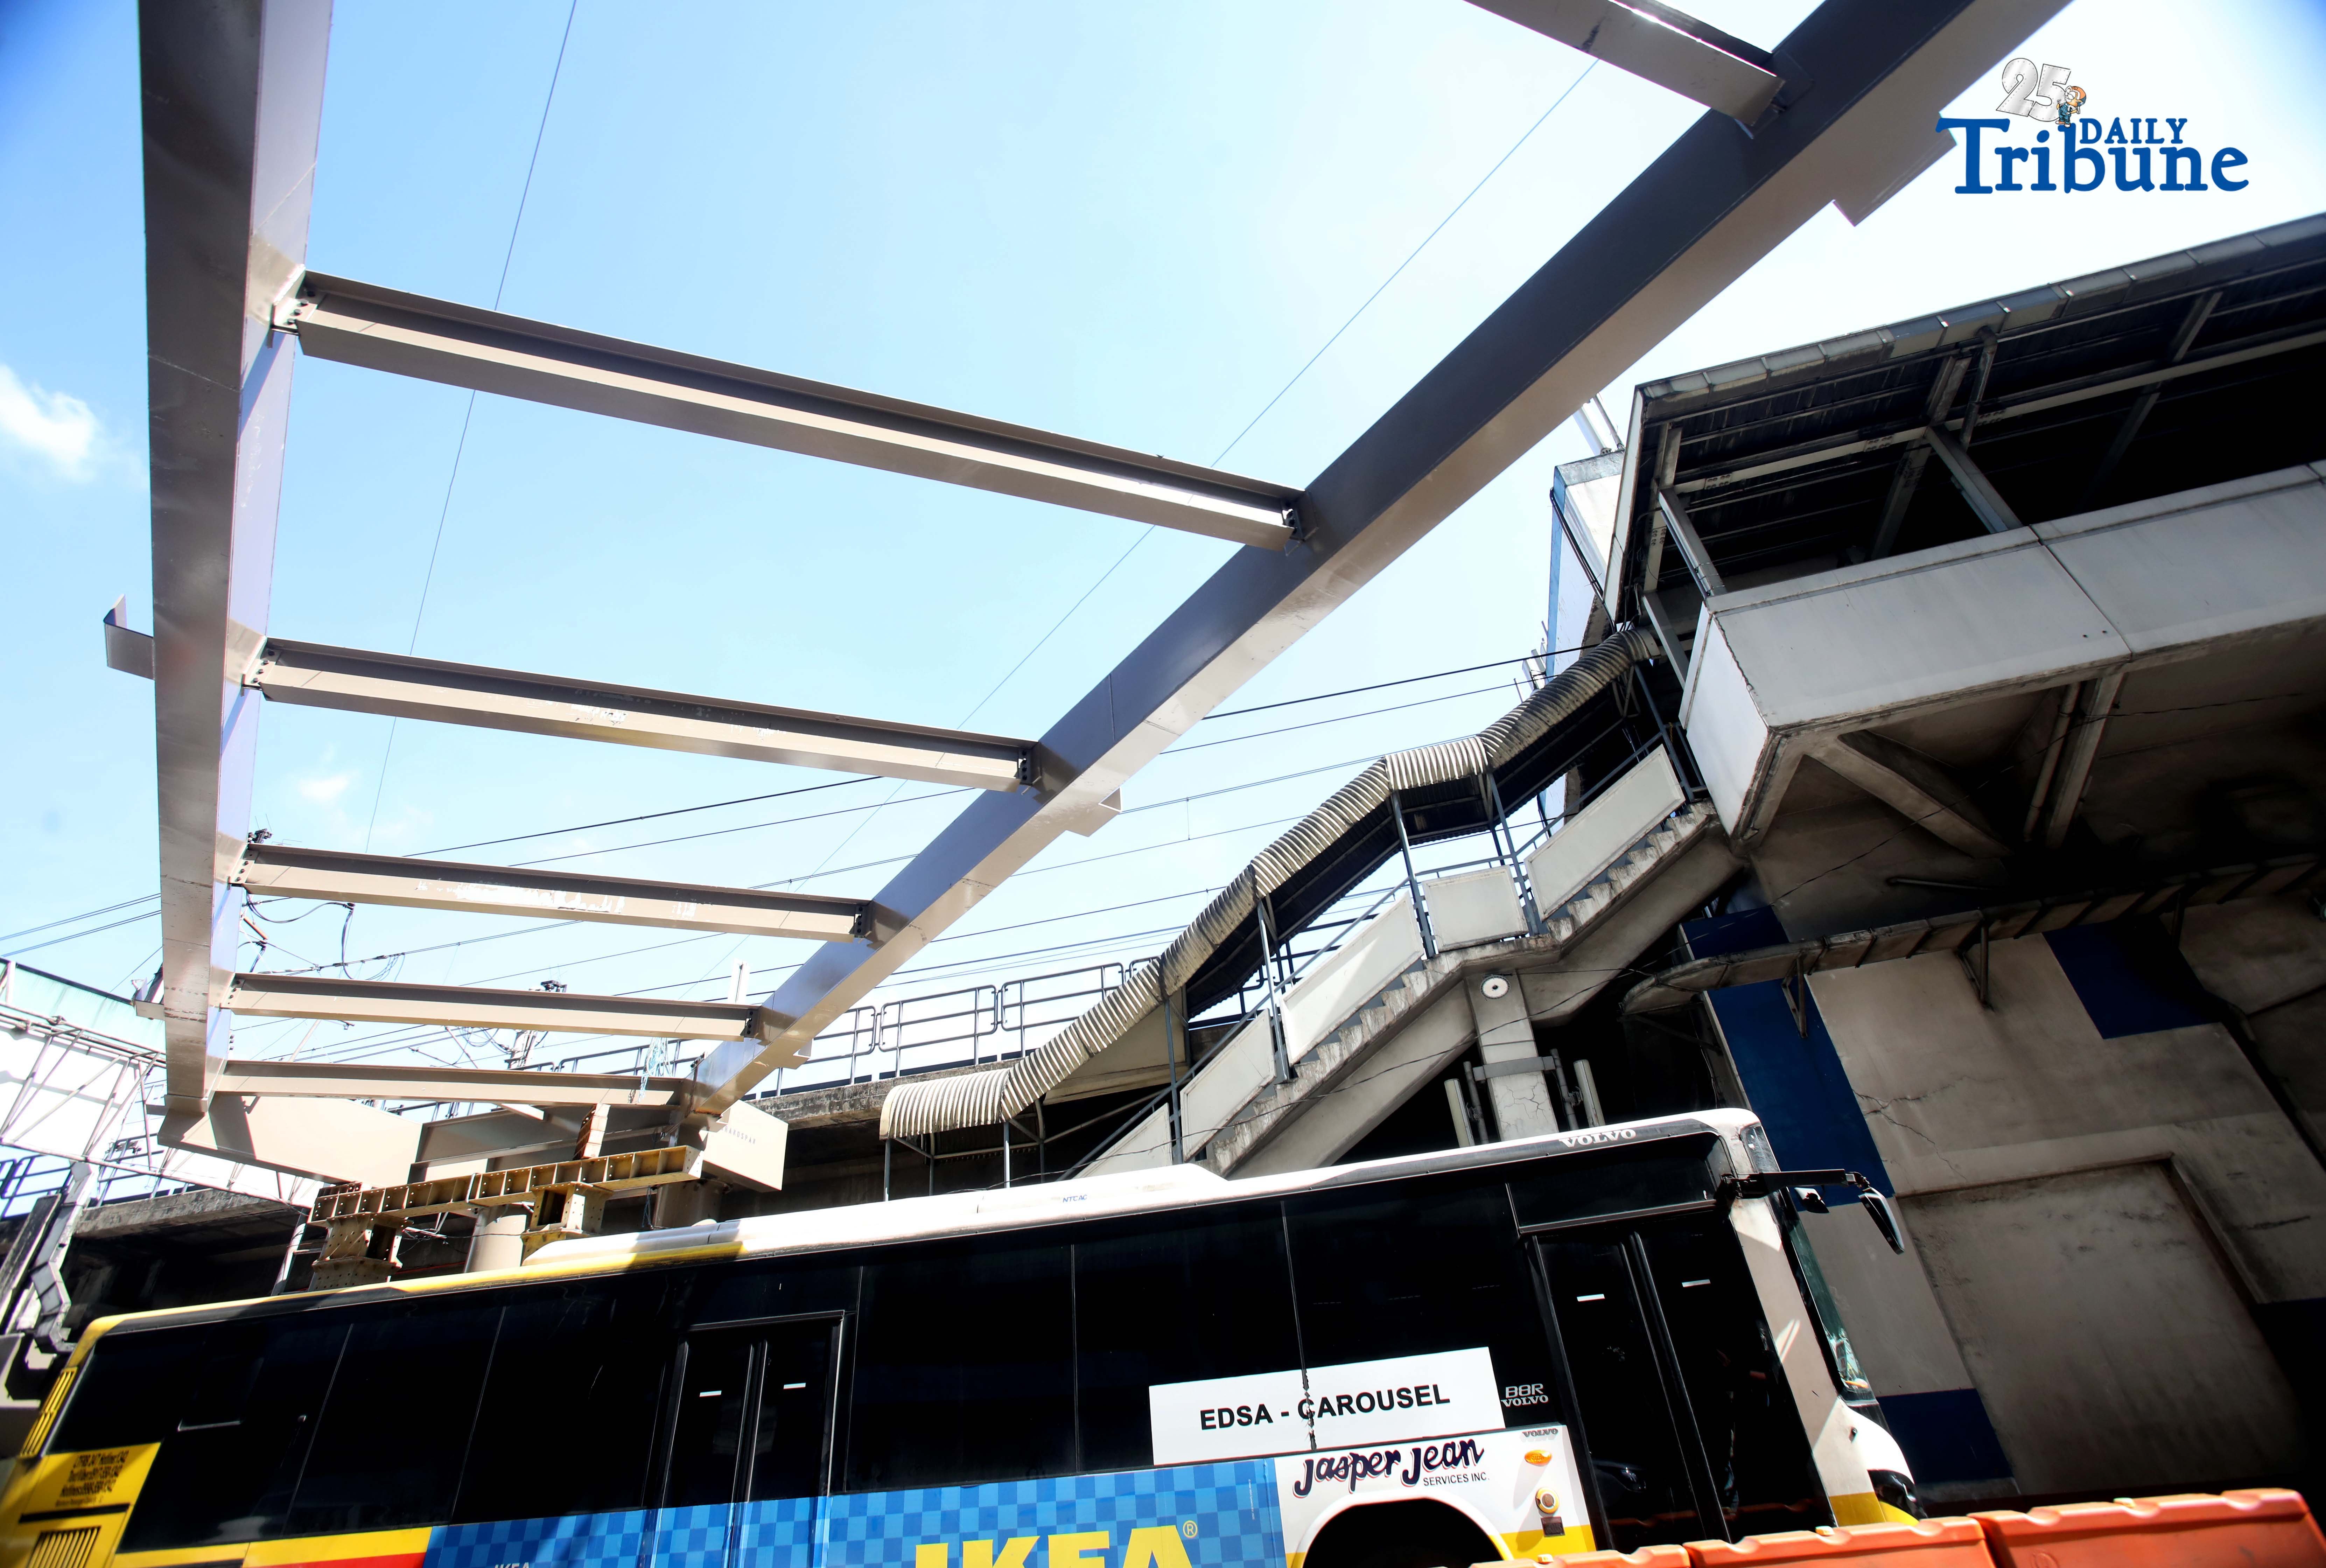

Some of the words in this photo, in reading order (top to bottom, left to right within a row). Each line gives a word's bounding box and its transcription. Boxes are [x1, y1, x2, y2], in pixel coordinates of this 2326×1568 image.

[722, 1125, 756, 1144] RANDSPAN
[1559, 1129, 1637, 1148] VOLVO
[1506, 1383, 1543, 1398] B8R
[1200, 1404, 1274, 1430] EDSA
[1298, 1384, 1451, 1420] CAROUSEL
[1501, 1395, 1548, 1407] VOLVO
[1522, 1428, 1558, 1437] VOLVO
[1423, 1475, 1469, 1486] SERVICES
[1471, 1472, 1490, 1481] INC.
